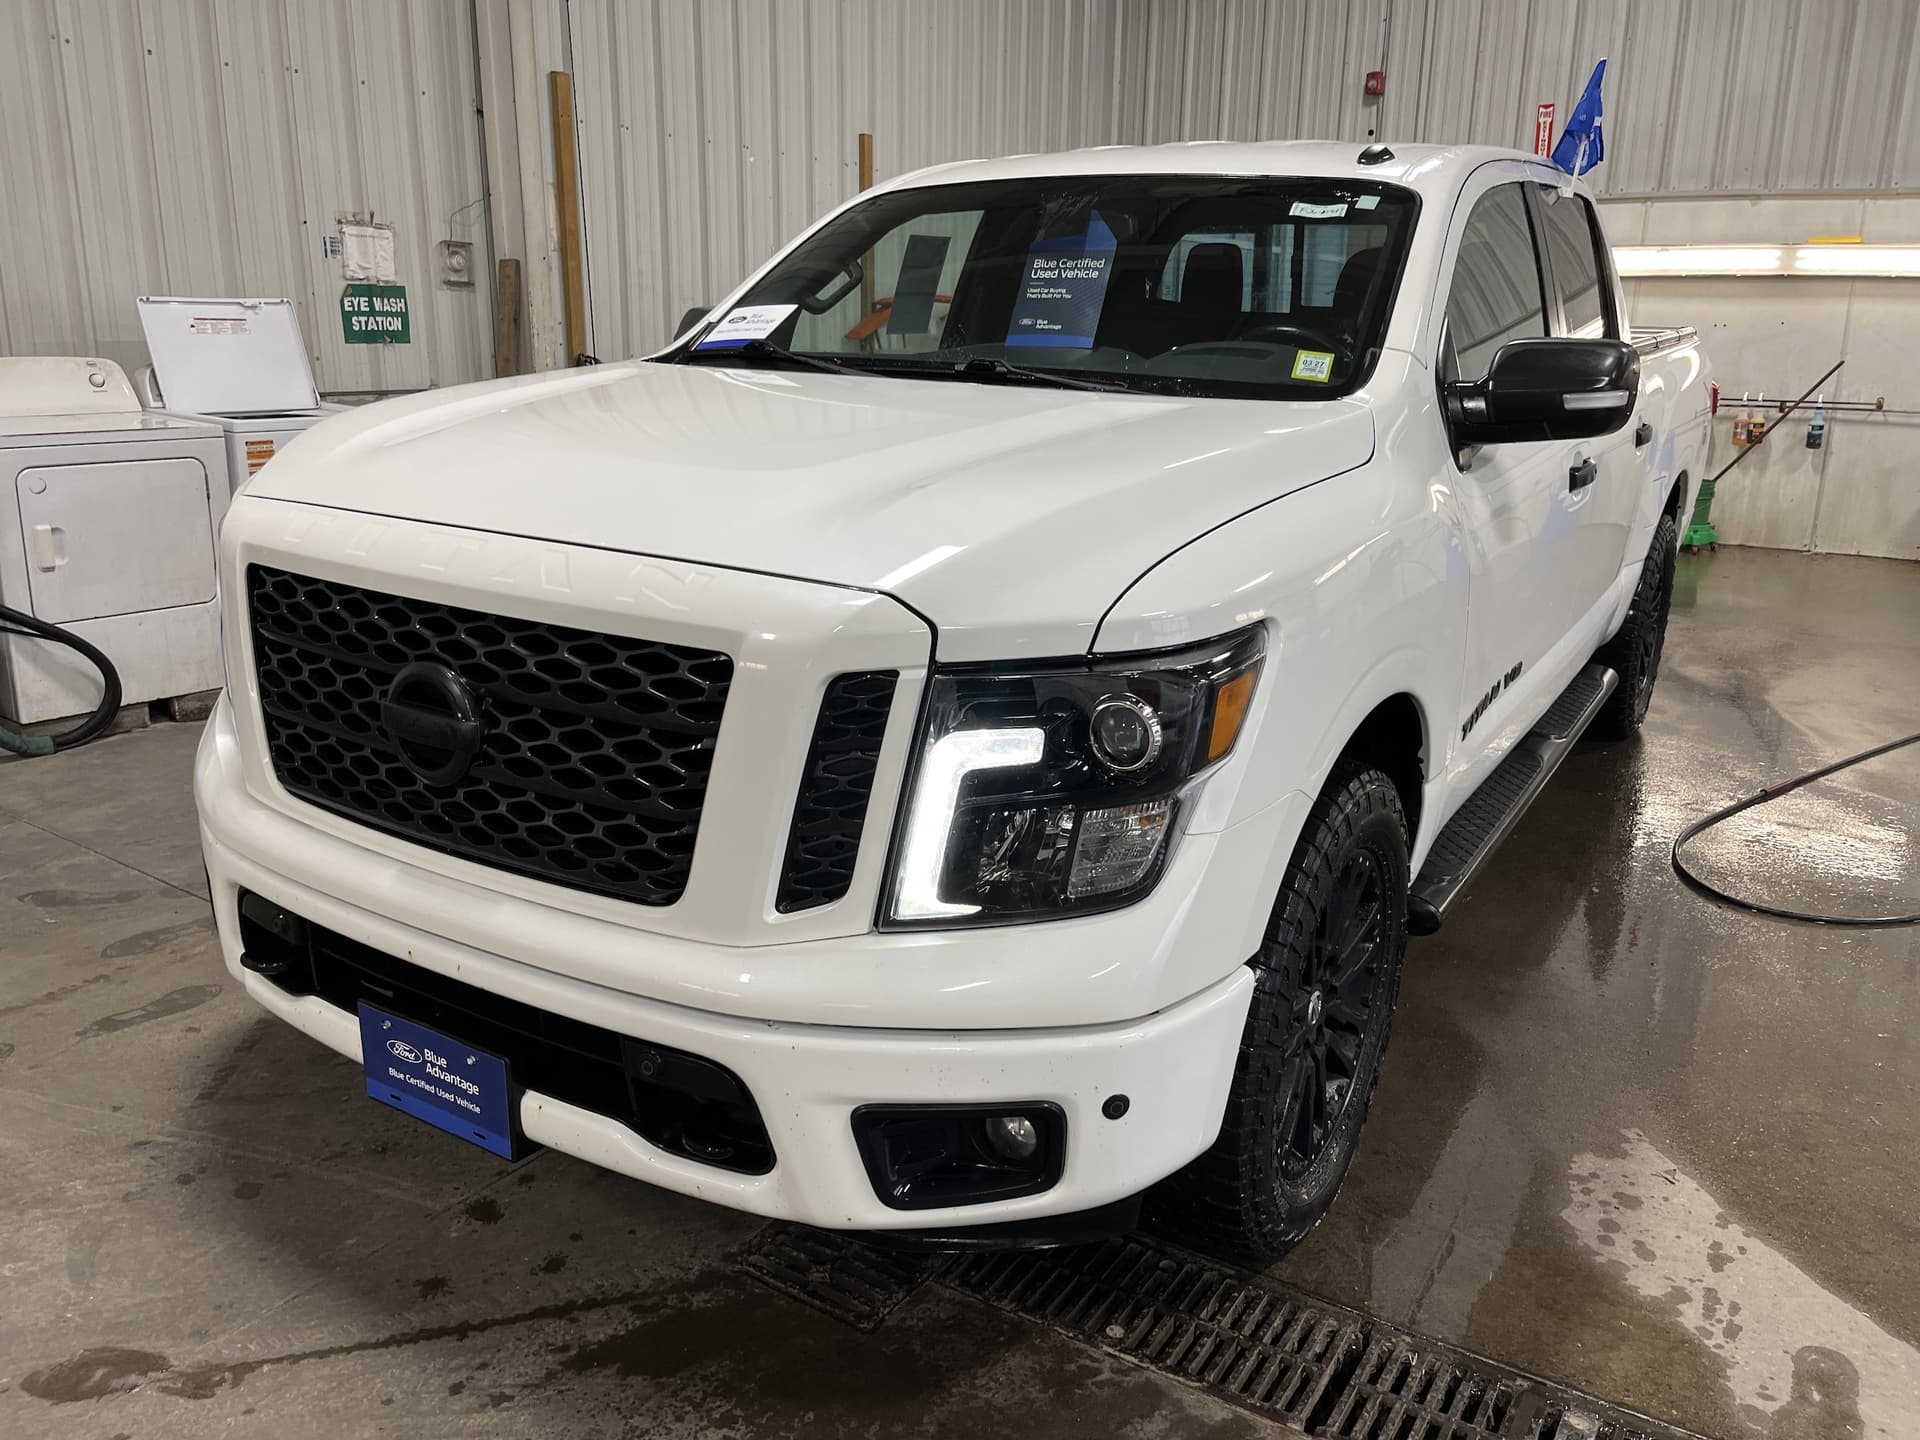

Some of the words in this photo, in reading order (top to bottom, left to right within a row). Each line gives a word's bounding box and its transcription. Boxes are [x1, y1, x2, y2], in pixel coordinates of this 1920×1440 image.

[1033, 259, 1057, 269] Blue
[1059, 258, 1105, 269] Certified
[1031, 269, 1059, 279] Used
[1061, 269, 1099, 279] Vehicle
[343, 297, 370, 312] EYE
[373, 297, 406, 313] WASH
[352, 316, 402, 331] STATION
[392, 1041, 416, 1061] Ford
[424, 1049, 448, 1068] Blue
[426, 1063, 480, 1096] Advantage
[388, 1067, 405, 1081] Blue
[405, 1074, 435, 1094] Certified
[436, 1087, 455, 1102] Used
[455, 1096, 481, 1114] Vehicle
